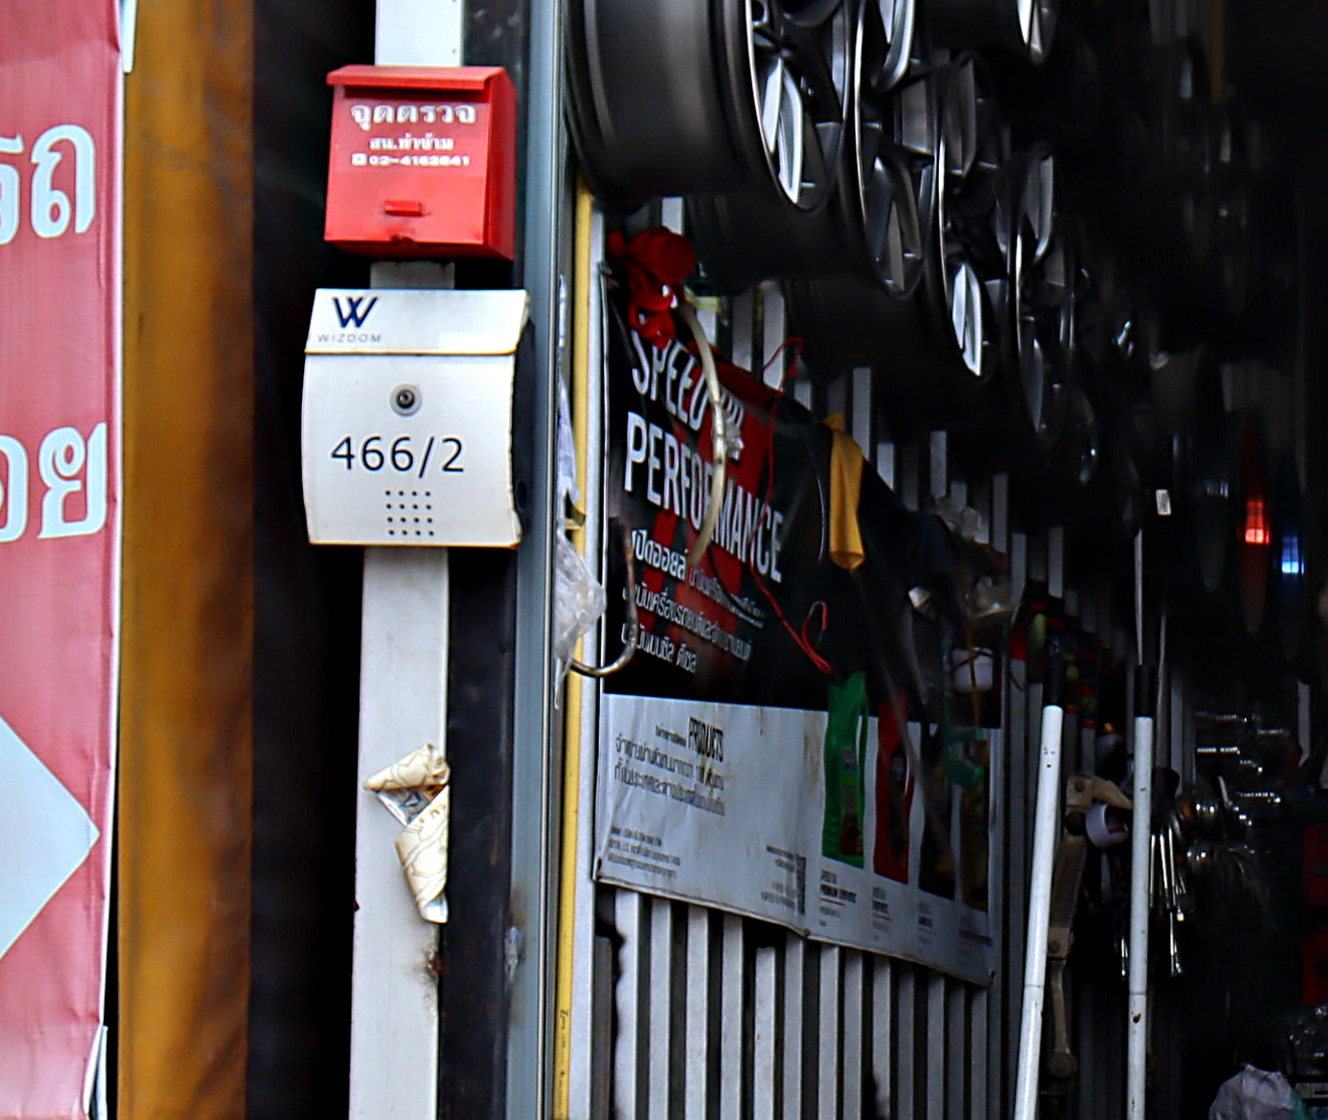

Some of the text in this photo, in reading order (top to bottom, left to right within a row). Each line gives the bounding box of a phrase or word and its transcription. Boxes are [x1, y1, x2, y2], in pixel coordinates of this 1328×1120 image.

[351, 103, 477, 131] จุดตรวจ
[332, 296, 379, 329] W
[317, 332, 383, 344] WIZDOM
[631, 328, 708, 430] SPEED
[330, 435, 465, 480] 466/2
